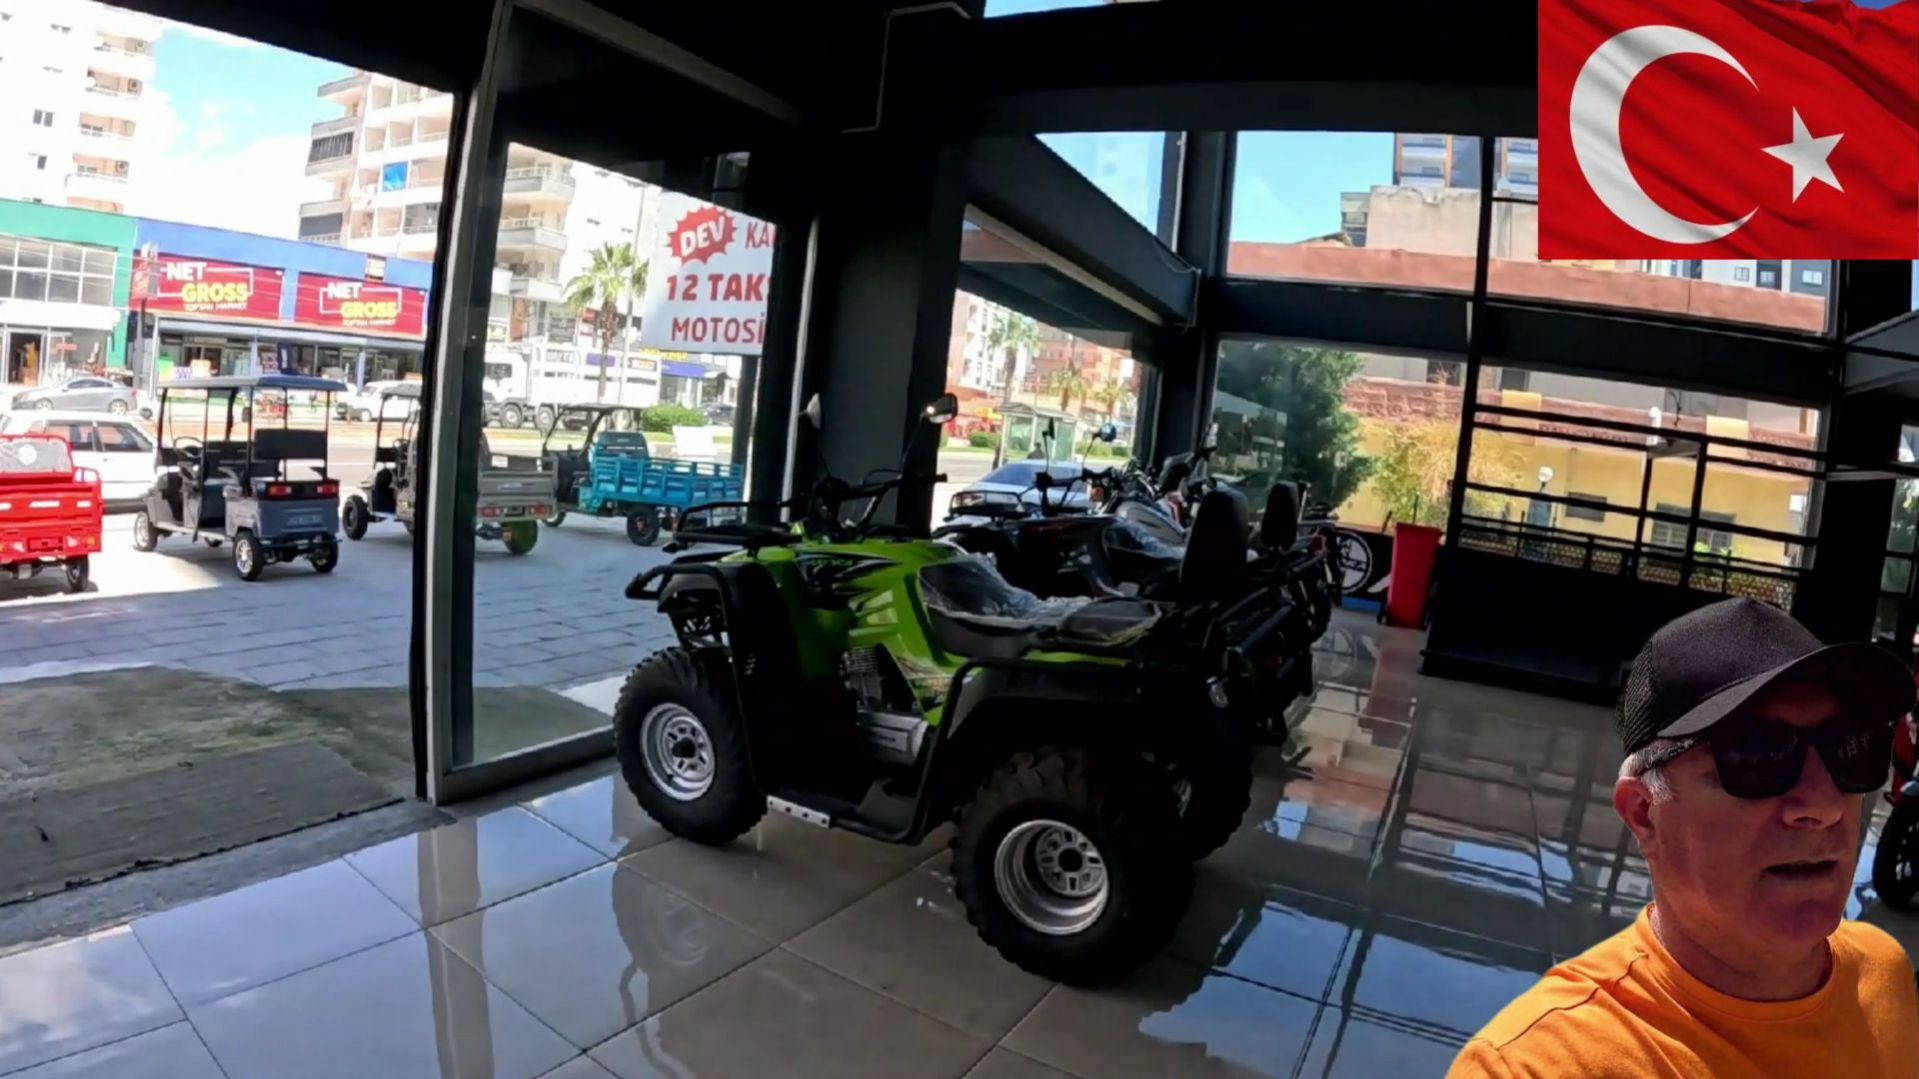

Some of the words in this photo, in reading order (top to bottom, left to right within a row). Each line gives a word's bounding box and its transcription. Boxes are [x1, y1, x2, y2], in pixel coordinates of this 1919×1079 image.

[680, 215, 725, 257] DEV
[166, 261, 207, 280] NET
[181, 282, 249, 302] GROSS
[327, 282, 363, 299] NET
[667, 274, 698, 301] 12
[340, 301, 398, 318] GROSS
